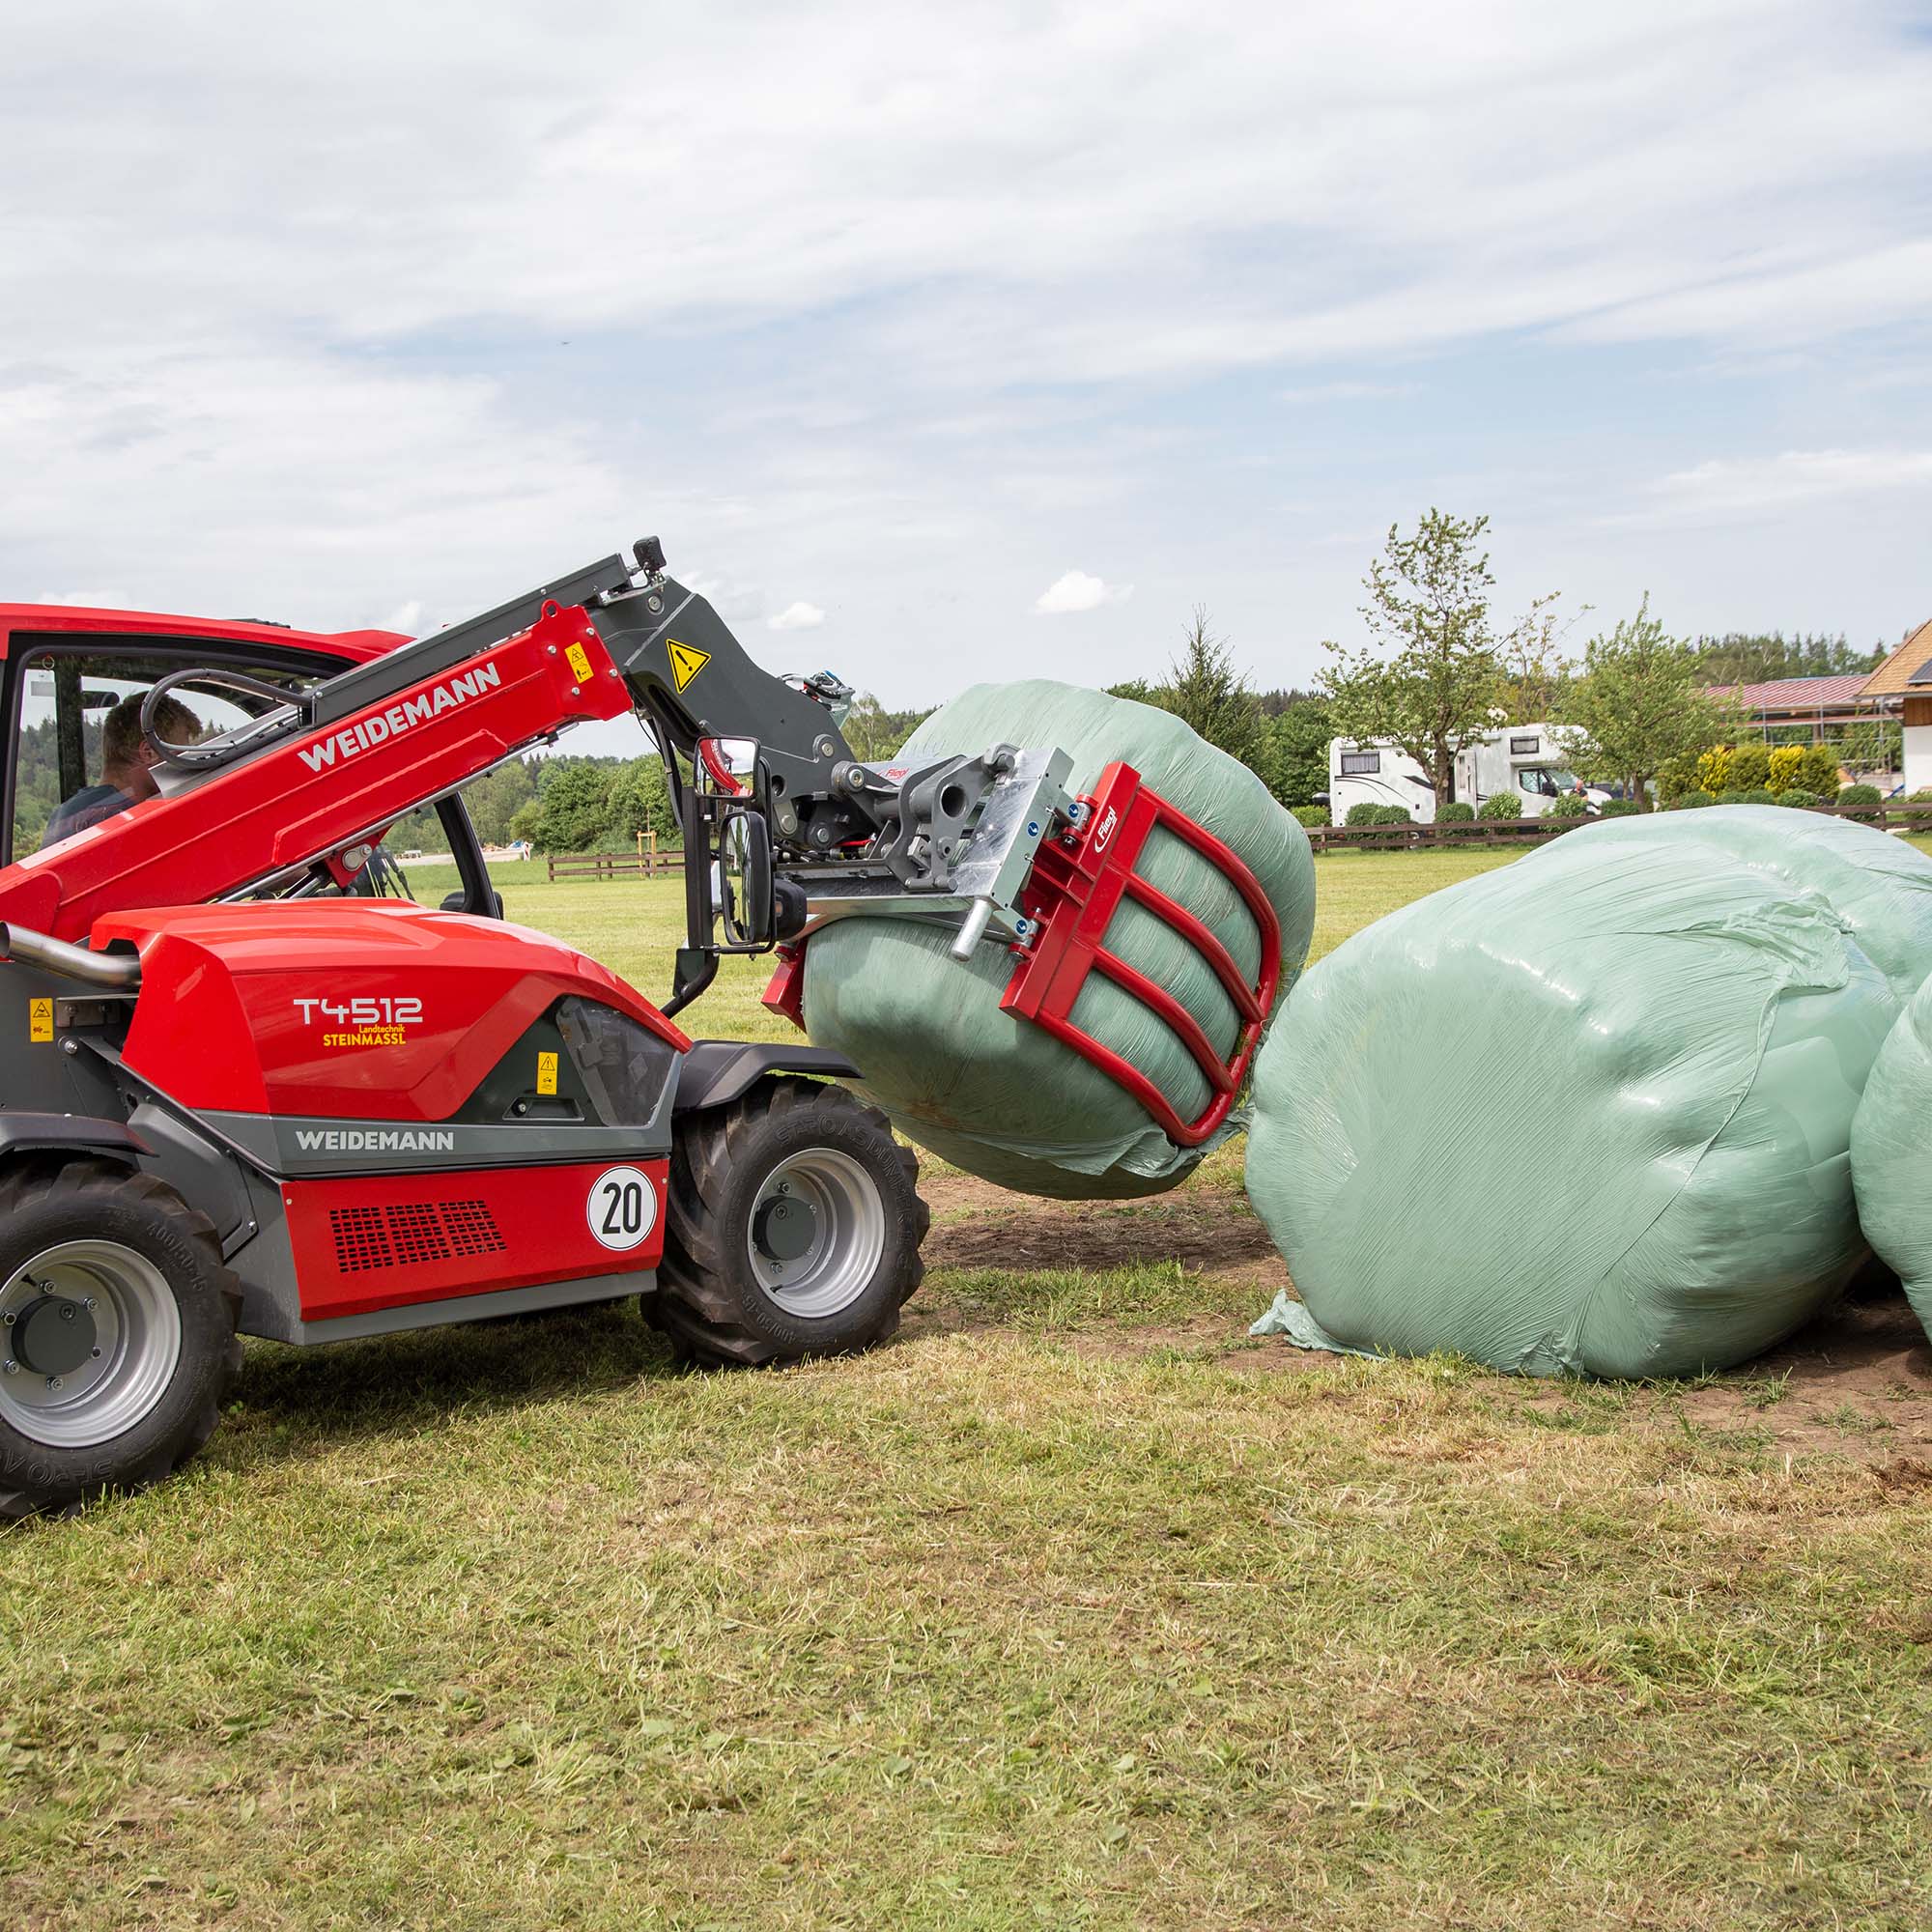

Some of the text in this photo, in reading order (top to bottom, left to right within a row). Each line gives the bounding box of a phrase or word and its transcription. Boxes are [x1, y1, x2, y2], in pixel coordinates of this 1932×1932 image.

[297, 662, 501, 773] WEIDEMANN
[1096, 806, 1118, 842] Fliegl
[293, 998, 423, 1025] T4512
[323, 1033, 407, 1046] STEINMASSL
[358, 1024, 406, 1034] Landtechnik
[296, 1130, 453, 1151] WEIDEMANN
[602, 1181, 642, 1235] 20
